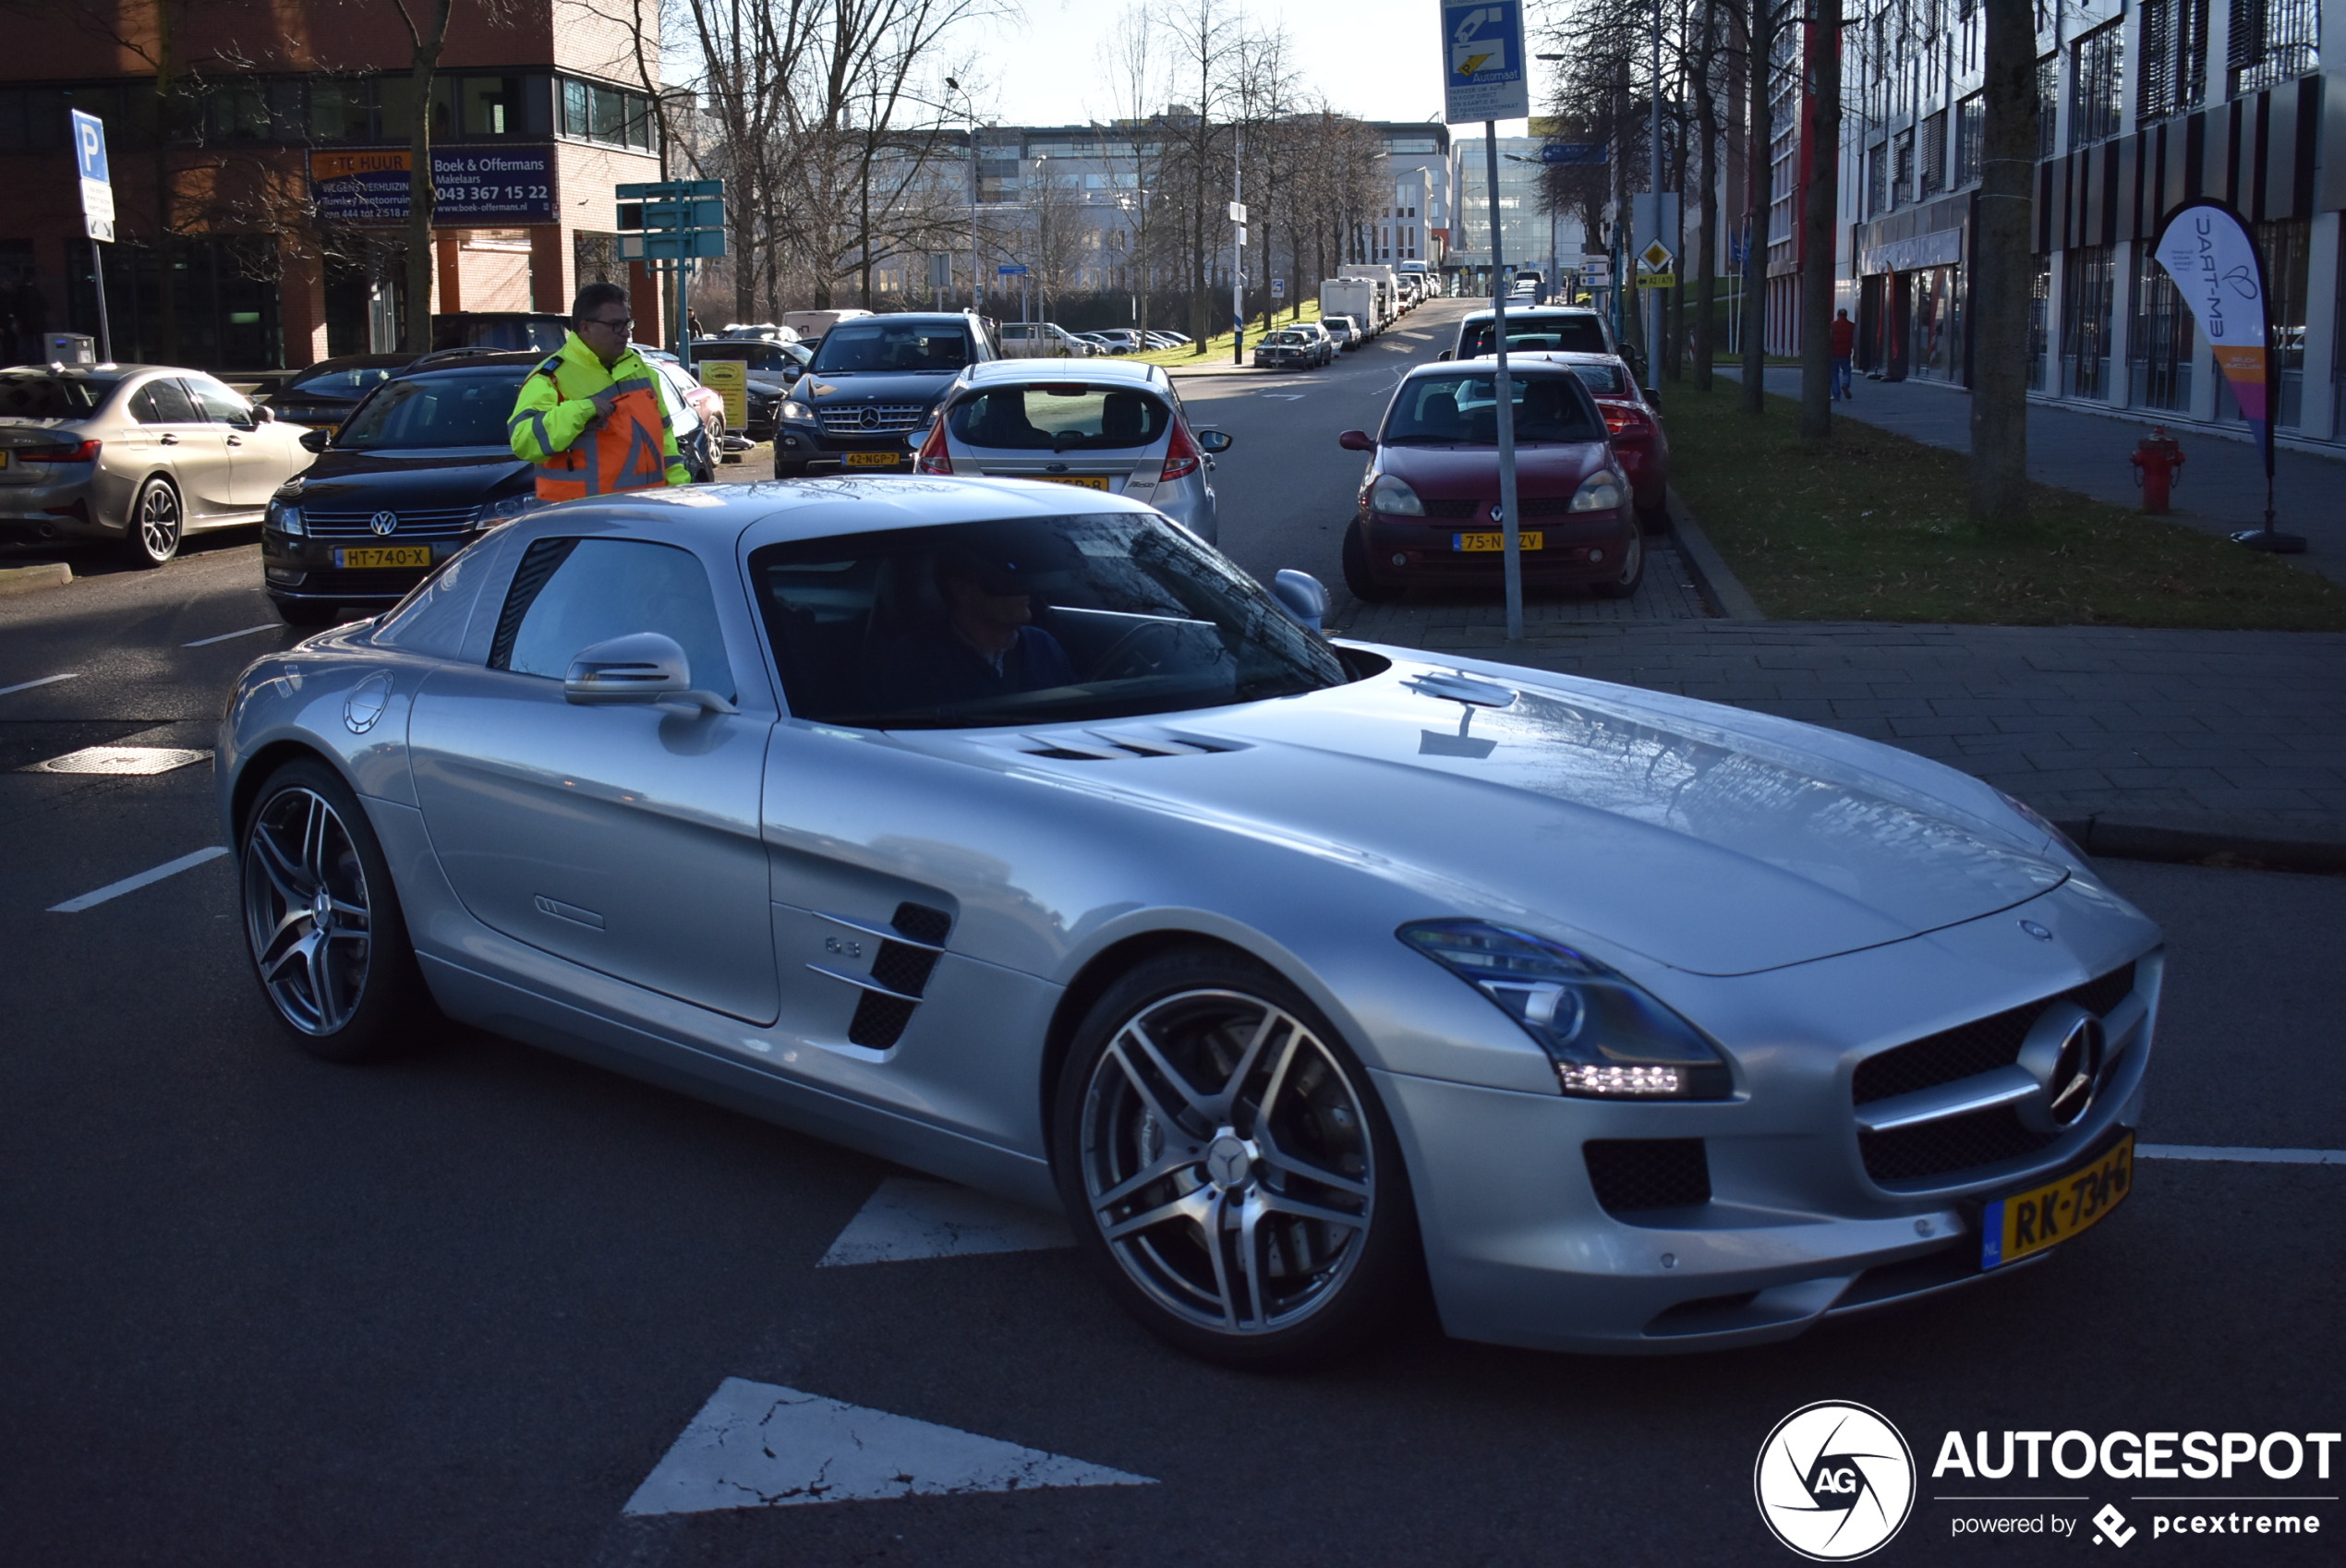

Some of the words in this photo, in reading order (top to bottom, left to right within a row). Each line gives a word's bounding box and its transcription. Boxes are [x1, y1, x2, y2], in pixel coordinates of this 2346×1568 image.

[1472, 70, 1518, 83] Automaat
[338, 156, 355, 171] TE
[361, 155, 404, 171] HUUR
[434, 158, 465, 173] Boek
[467, 159, 477, 172] &
[479, 157, 545, 172] Offermans
[436, 174, 481, 185] Makelaars
[437, 187, 466, 200] 043
[470, 187, 500, 200] 367
[504, 186, 524, 199] 15
[528, 186, 548, 199] 22
[437, 202, 527, 212] www.boek-offermans.nl
[342, 209, 358, 218] 444
[360, 210, 373, 218] tot
[1649, 276, 1657, 284] A2
[849, 453, 896, 464] 42-NGP-7
[348, 549, 423, 566] HT-740-X
